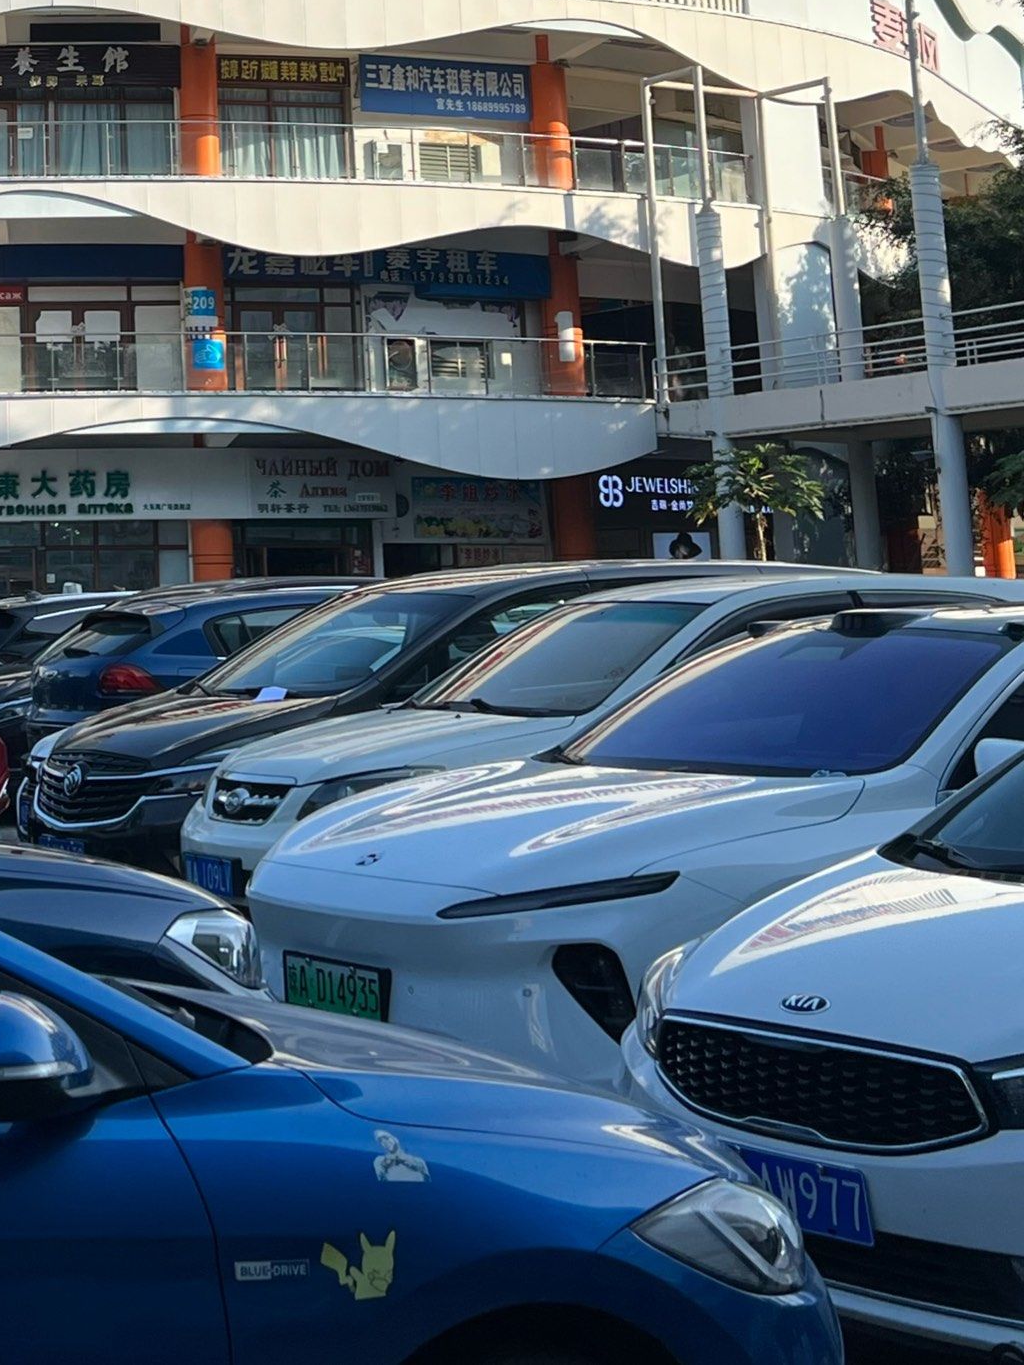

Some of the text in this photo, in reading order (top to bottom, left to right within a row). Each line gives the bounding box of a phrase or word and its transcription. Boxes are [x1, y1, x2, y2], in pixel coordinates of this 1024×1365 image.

[220, 59, 239, 79] 按摩
[241, 59, 259, 80] 足疗
[280, 60, 298, 81] 美容
[299, 61, 318, 82] 美体
[319, 62, 345, 83] 营业中
[365, 63, 526, 99] 三亚鑫和汽车租赁有限公司
[192, 295, 216, 310] 209
[255, 456, 391, 480] ЧАЙНЫЙ ДОМ
[77, 501, 134, 515] аптека
[785, 994, 821, 1011] KIA
